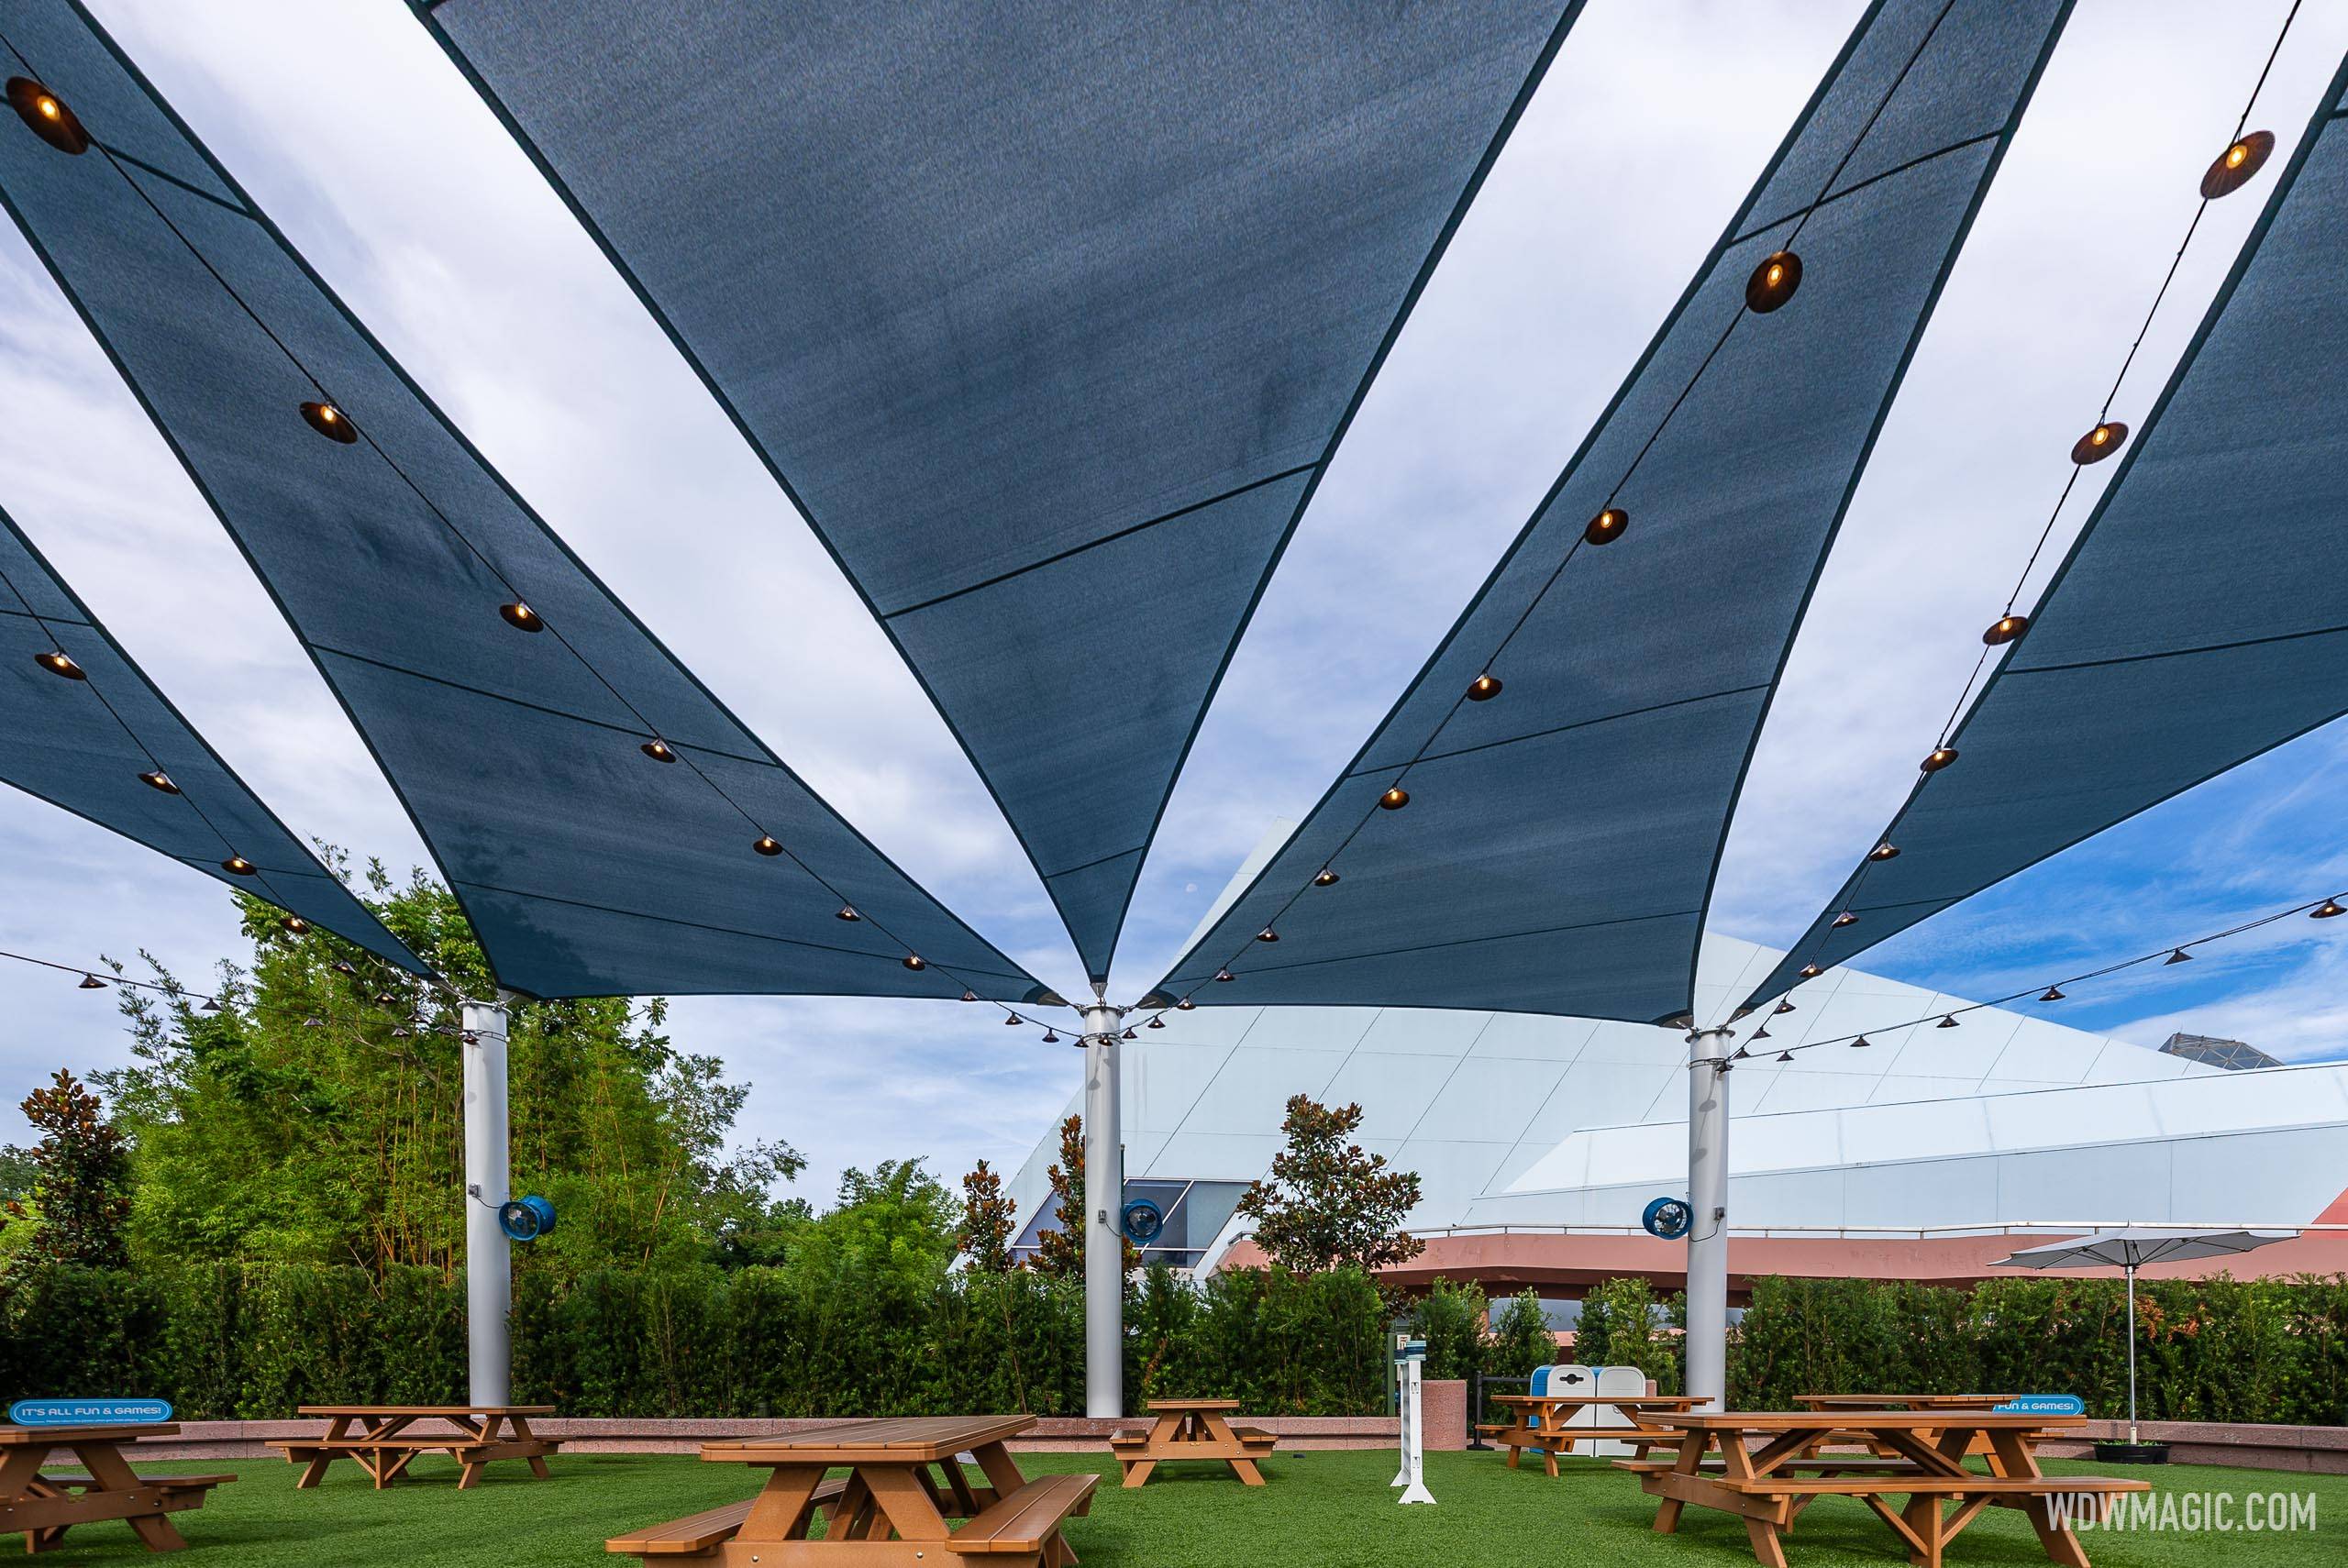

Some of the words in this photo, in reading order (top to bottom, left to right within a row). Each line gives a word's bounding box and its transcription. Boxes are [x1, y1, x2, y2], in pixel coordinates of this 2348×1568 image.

[22, 1408, 46, 1416] IT'S
[48, 1408, 72, 1416] ALL
[103, 1407, 112, 1415] &
[114, 1407, 161, 1415] GAMES!
